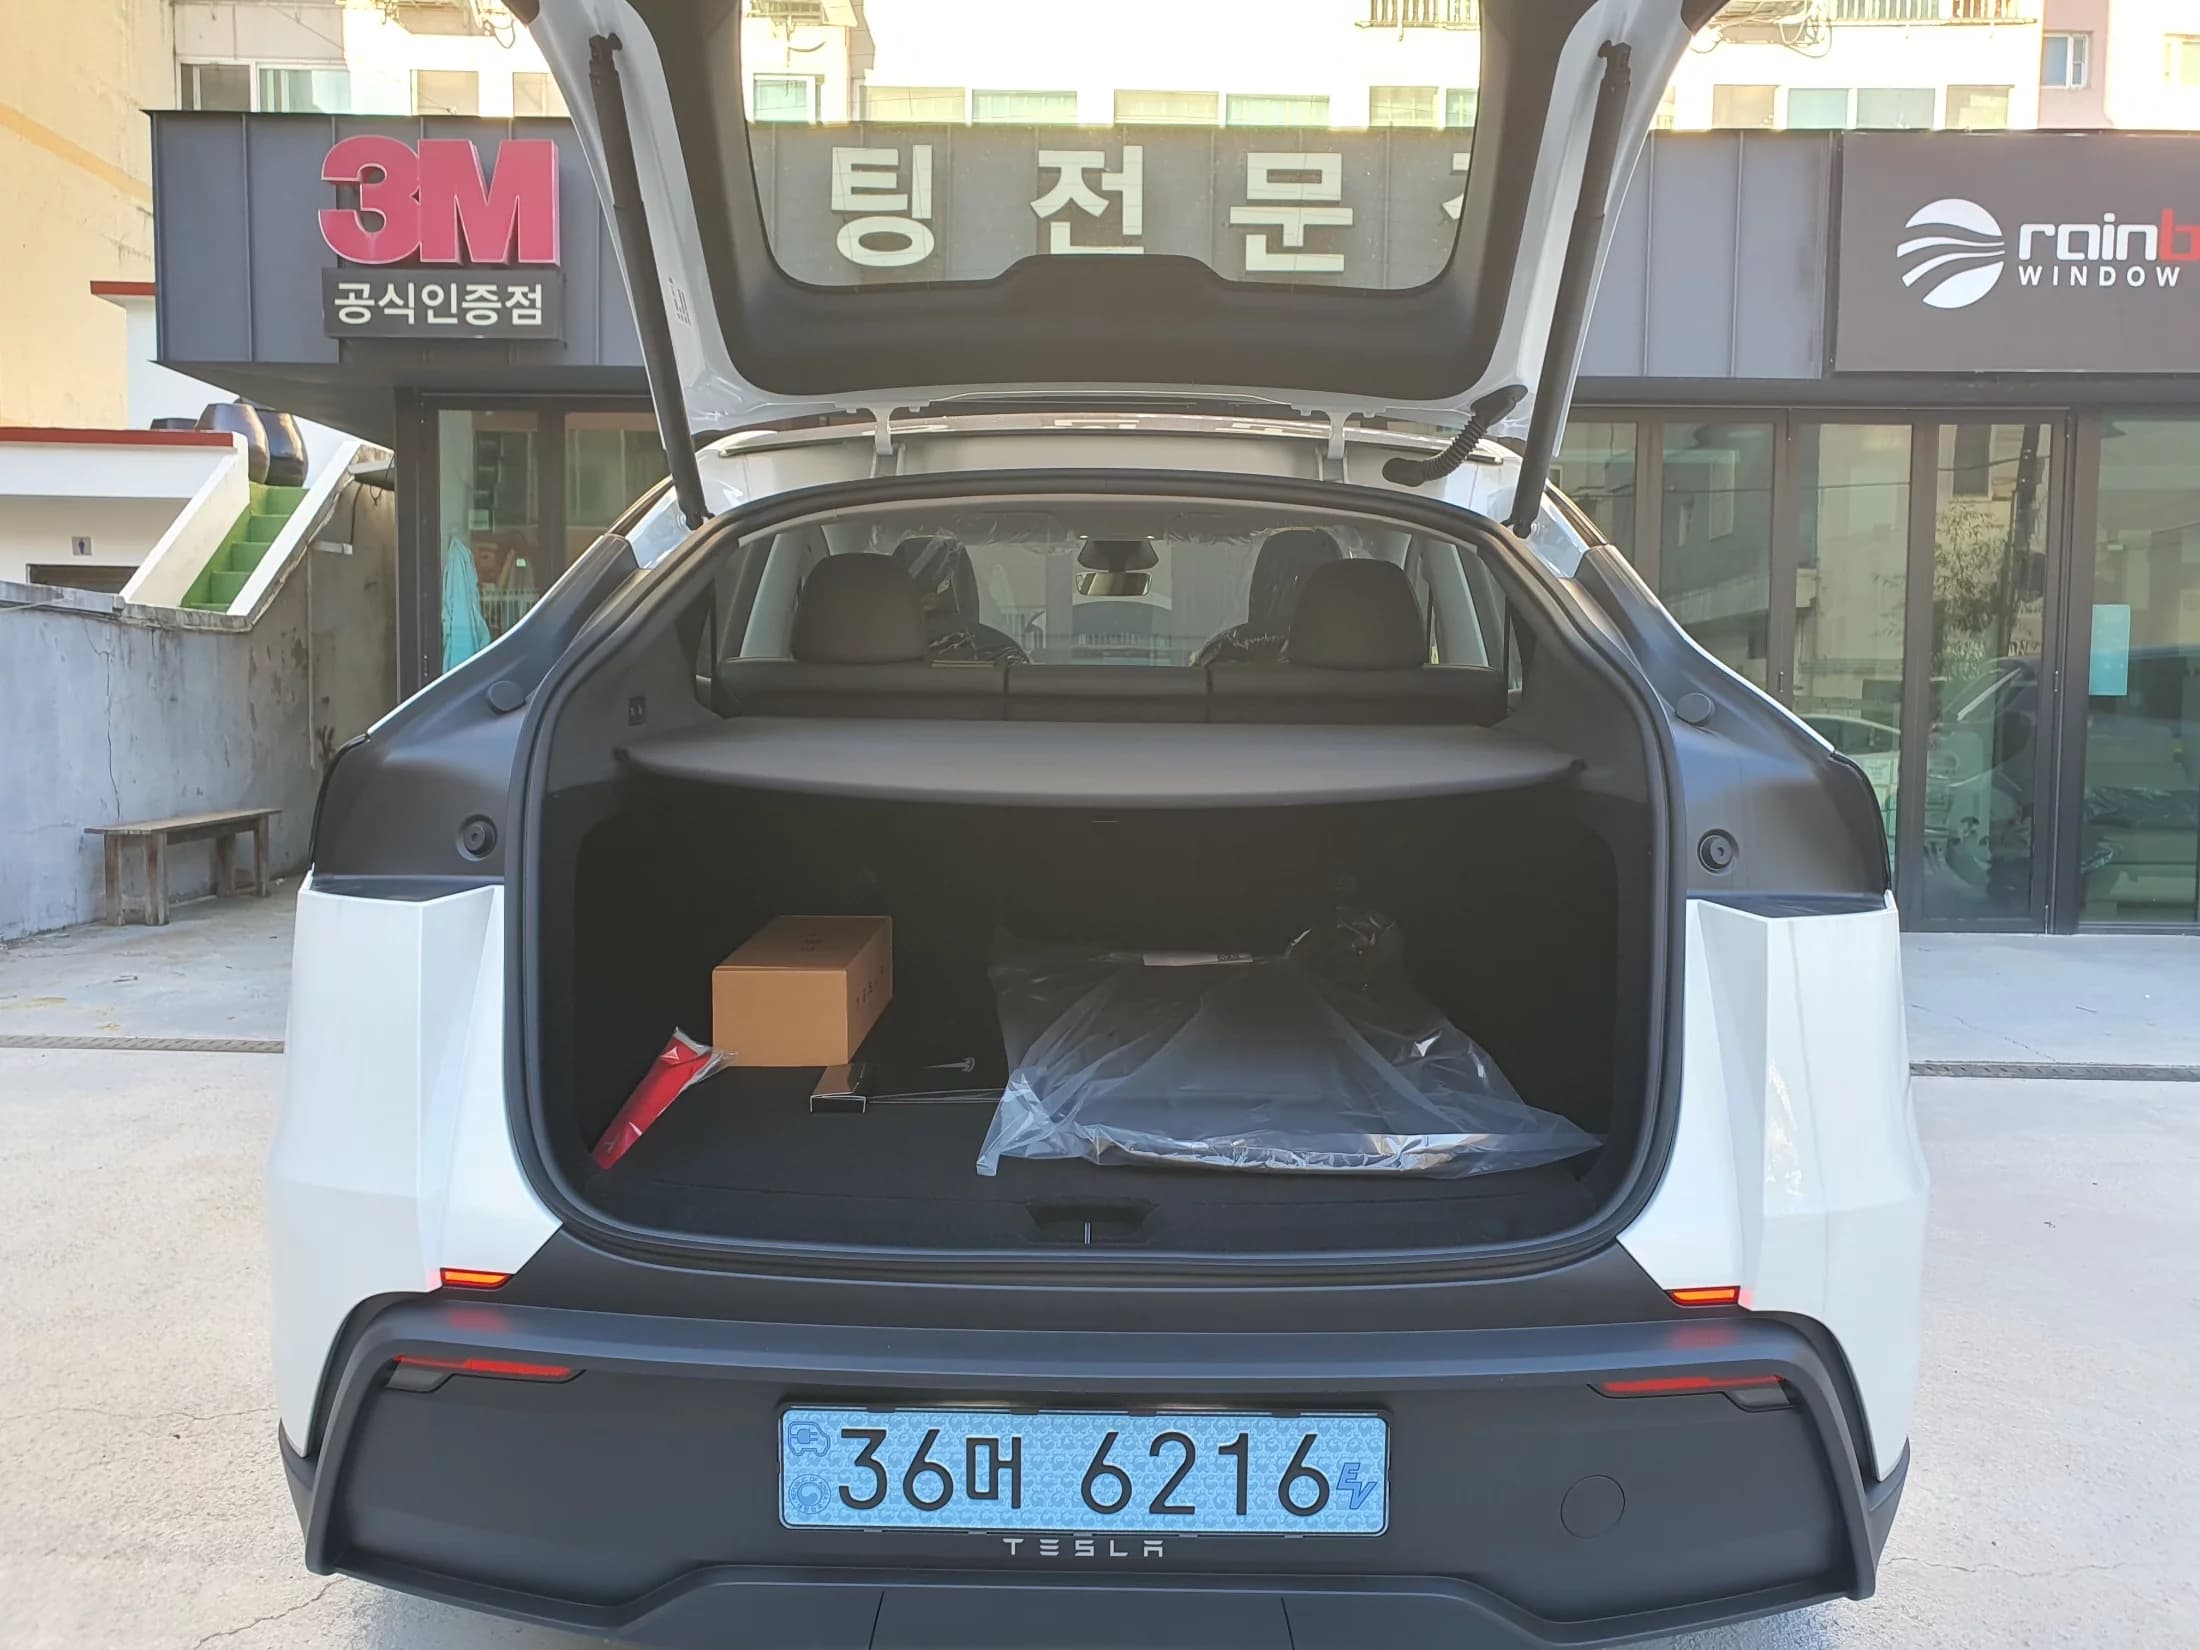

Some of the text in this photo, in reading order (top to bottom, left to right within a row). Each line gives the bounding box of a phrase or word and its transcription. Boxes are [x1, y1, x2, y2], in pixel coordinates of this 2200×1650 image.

[318, 134, 560, 266] 3M
[2018, 265, 2181, 287] WINDOW
[334, 282, 543, 326] 공식인증점
[838, 1428, 1022, 1511] 36머
[1081, 1431, 1330, 1517] 6216
[1336, 1462, 1378, 1511] EV
[1002, 1538, 1164, 1558] TESLA
